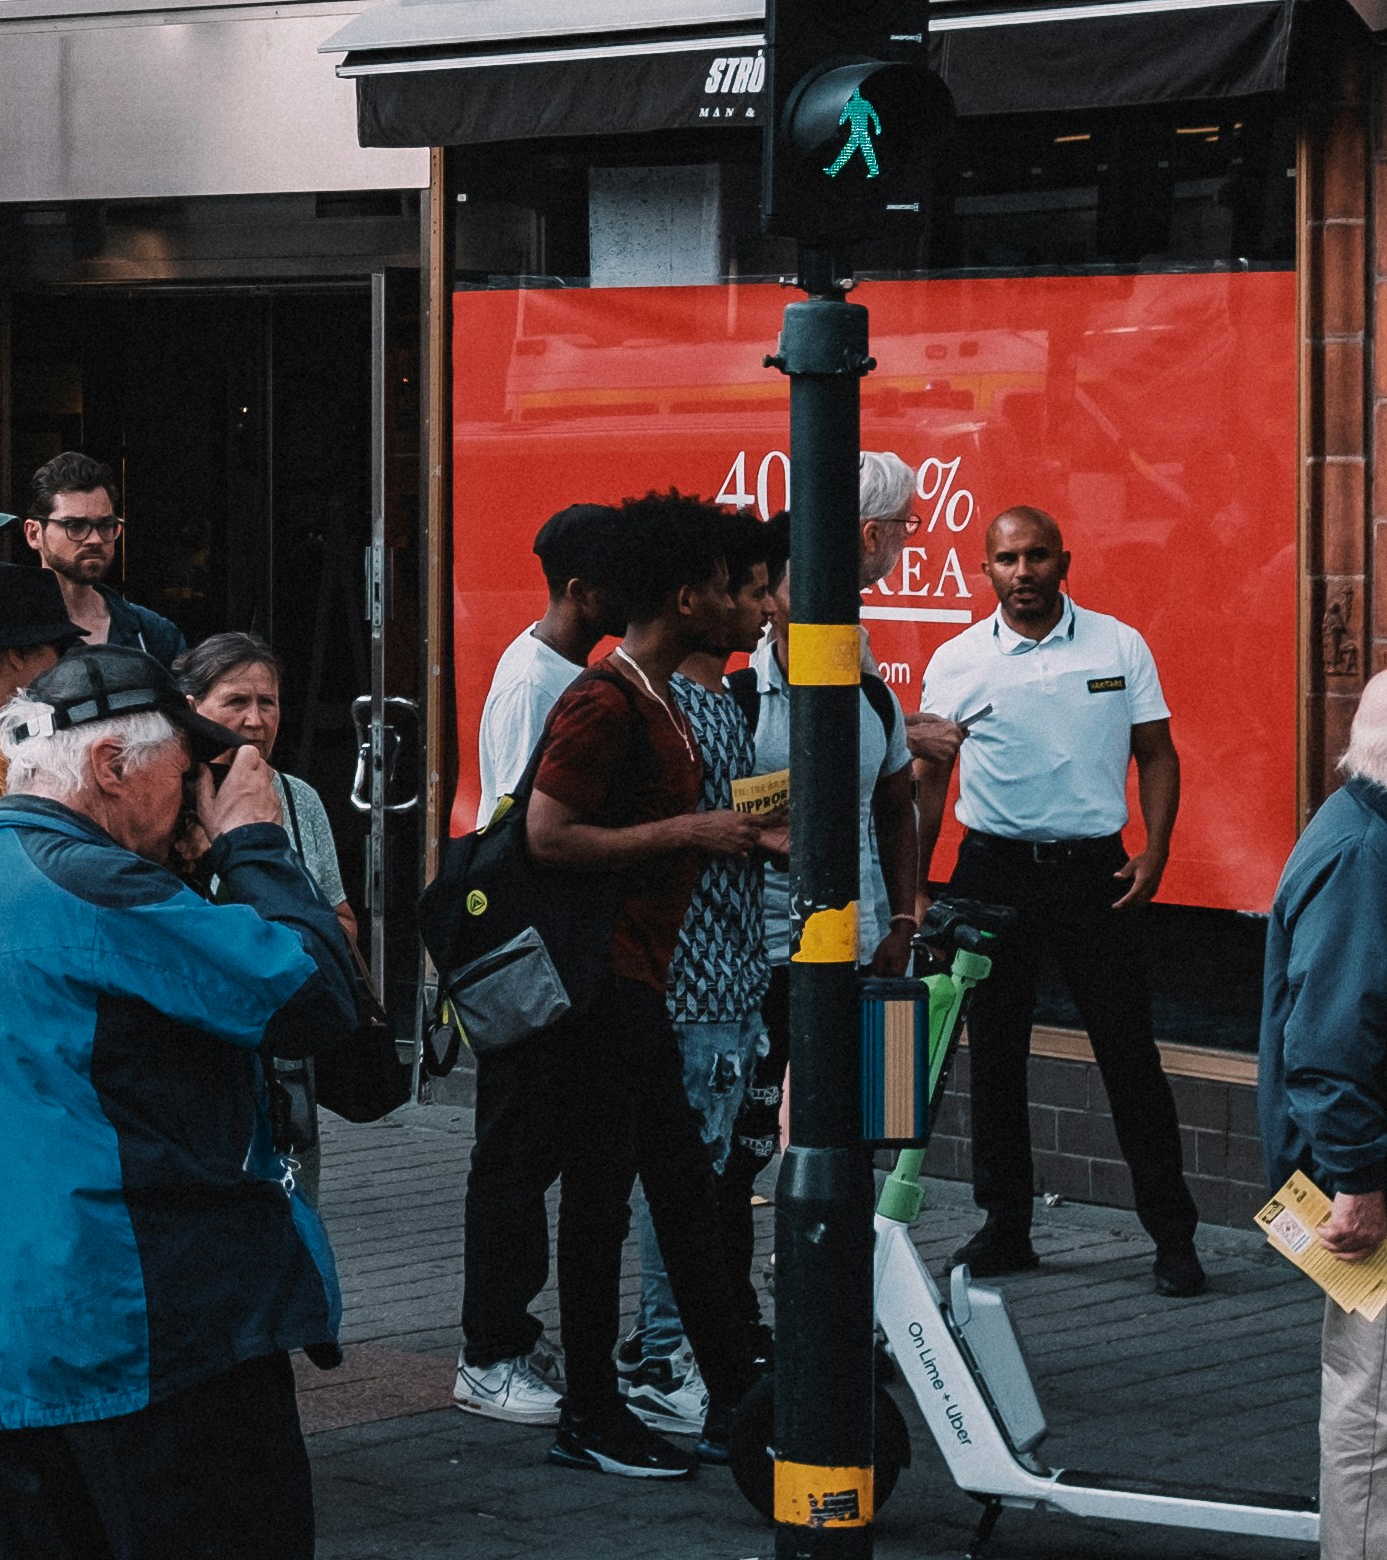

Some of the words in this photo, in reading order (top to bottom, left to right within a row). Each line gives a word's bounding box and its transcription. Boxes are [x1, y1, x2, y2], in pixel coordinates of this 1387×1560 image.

[704, 49, 766, 95] STRÖ
[698, 107, 735, 118] MAN
[745, 107, 756, 118] &
[908, 1321, 925, 1349] On
[918, 1348, 944, 1391] Lime
[945, 1403, 973, 1446] Uber
